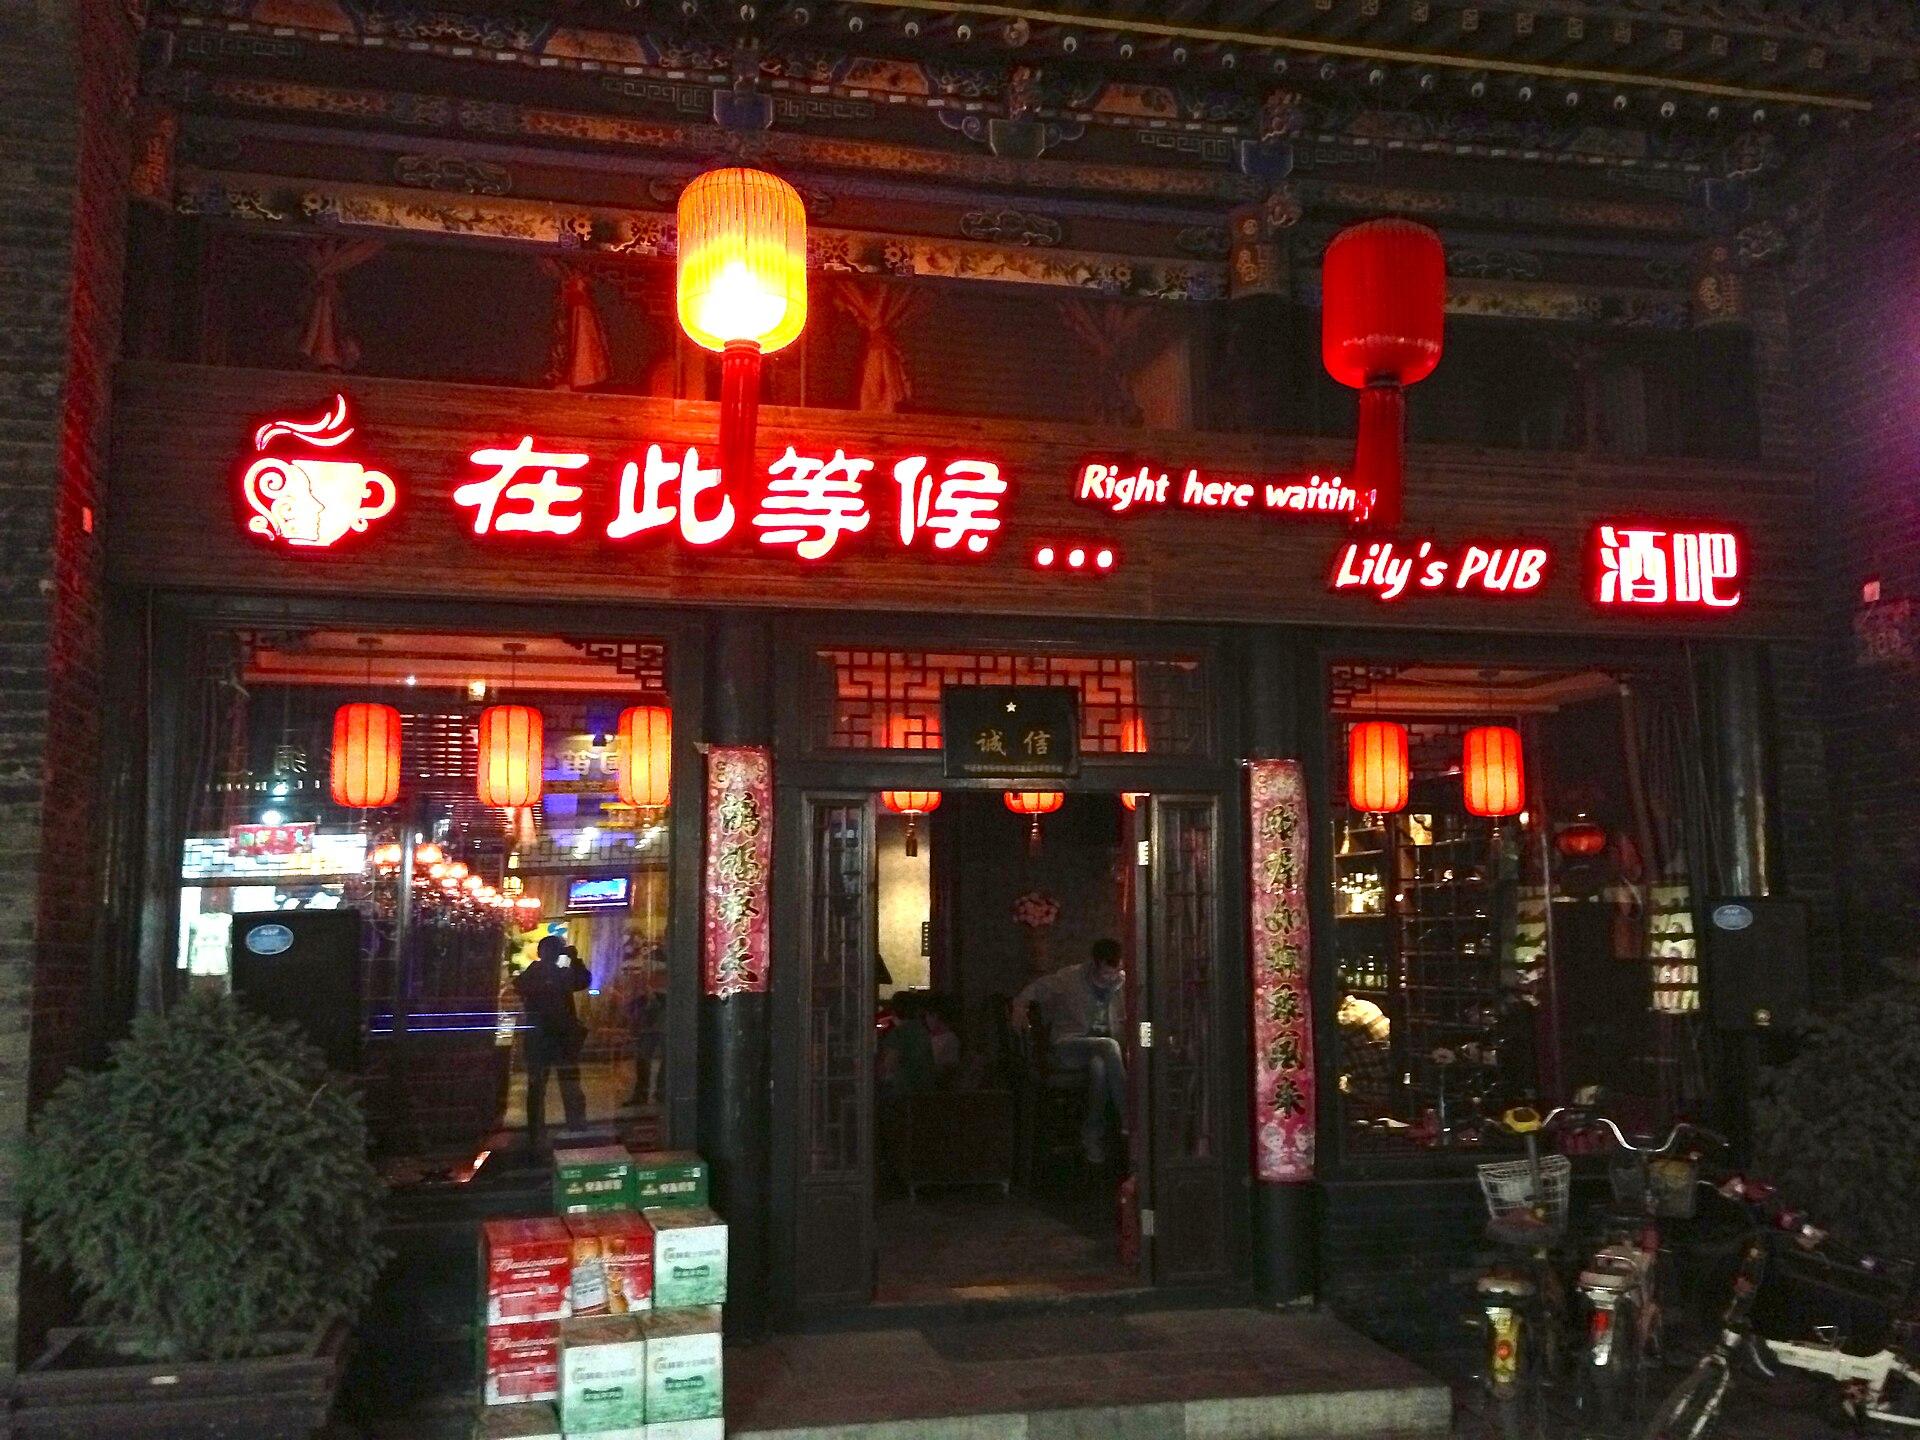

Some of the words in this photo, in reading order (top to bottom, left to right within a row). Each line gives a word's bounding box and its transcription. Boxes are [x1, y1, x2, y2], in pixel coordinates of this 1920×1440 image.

[453, 435, 1008, 560] 在此等候
[1080, 464, 1170, 511] Right
[1183, 469, 1255, 507] here
[1265, 475, 1377, 522] waitin
[1335, 541, 1446, 599] Lily's
[1456, 546, 1547, 591] PUB
[1600, 526, 1740, 607] 酒吧
